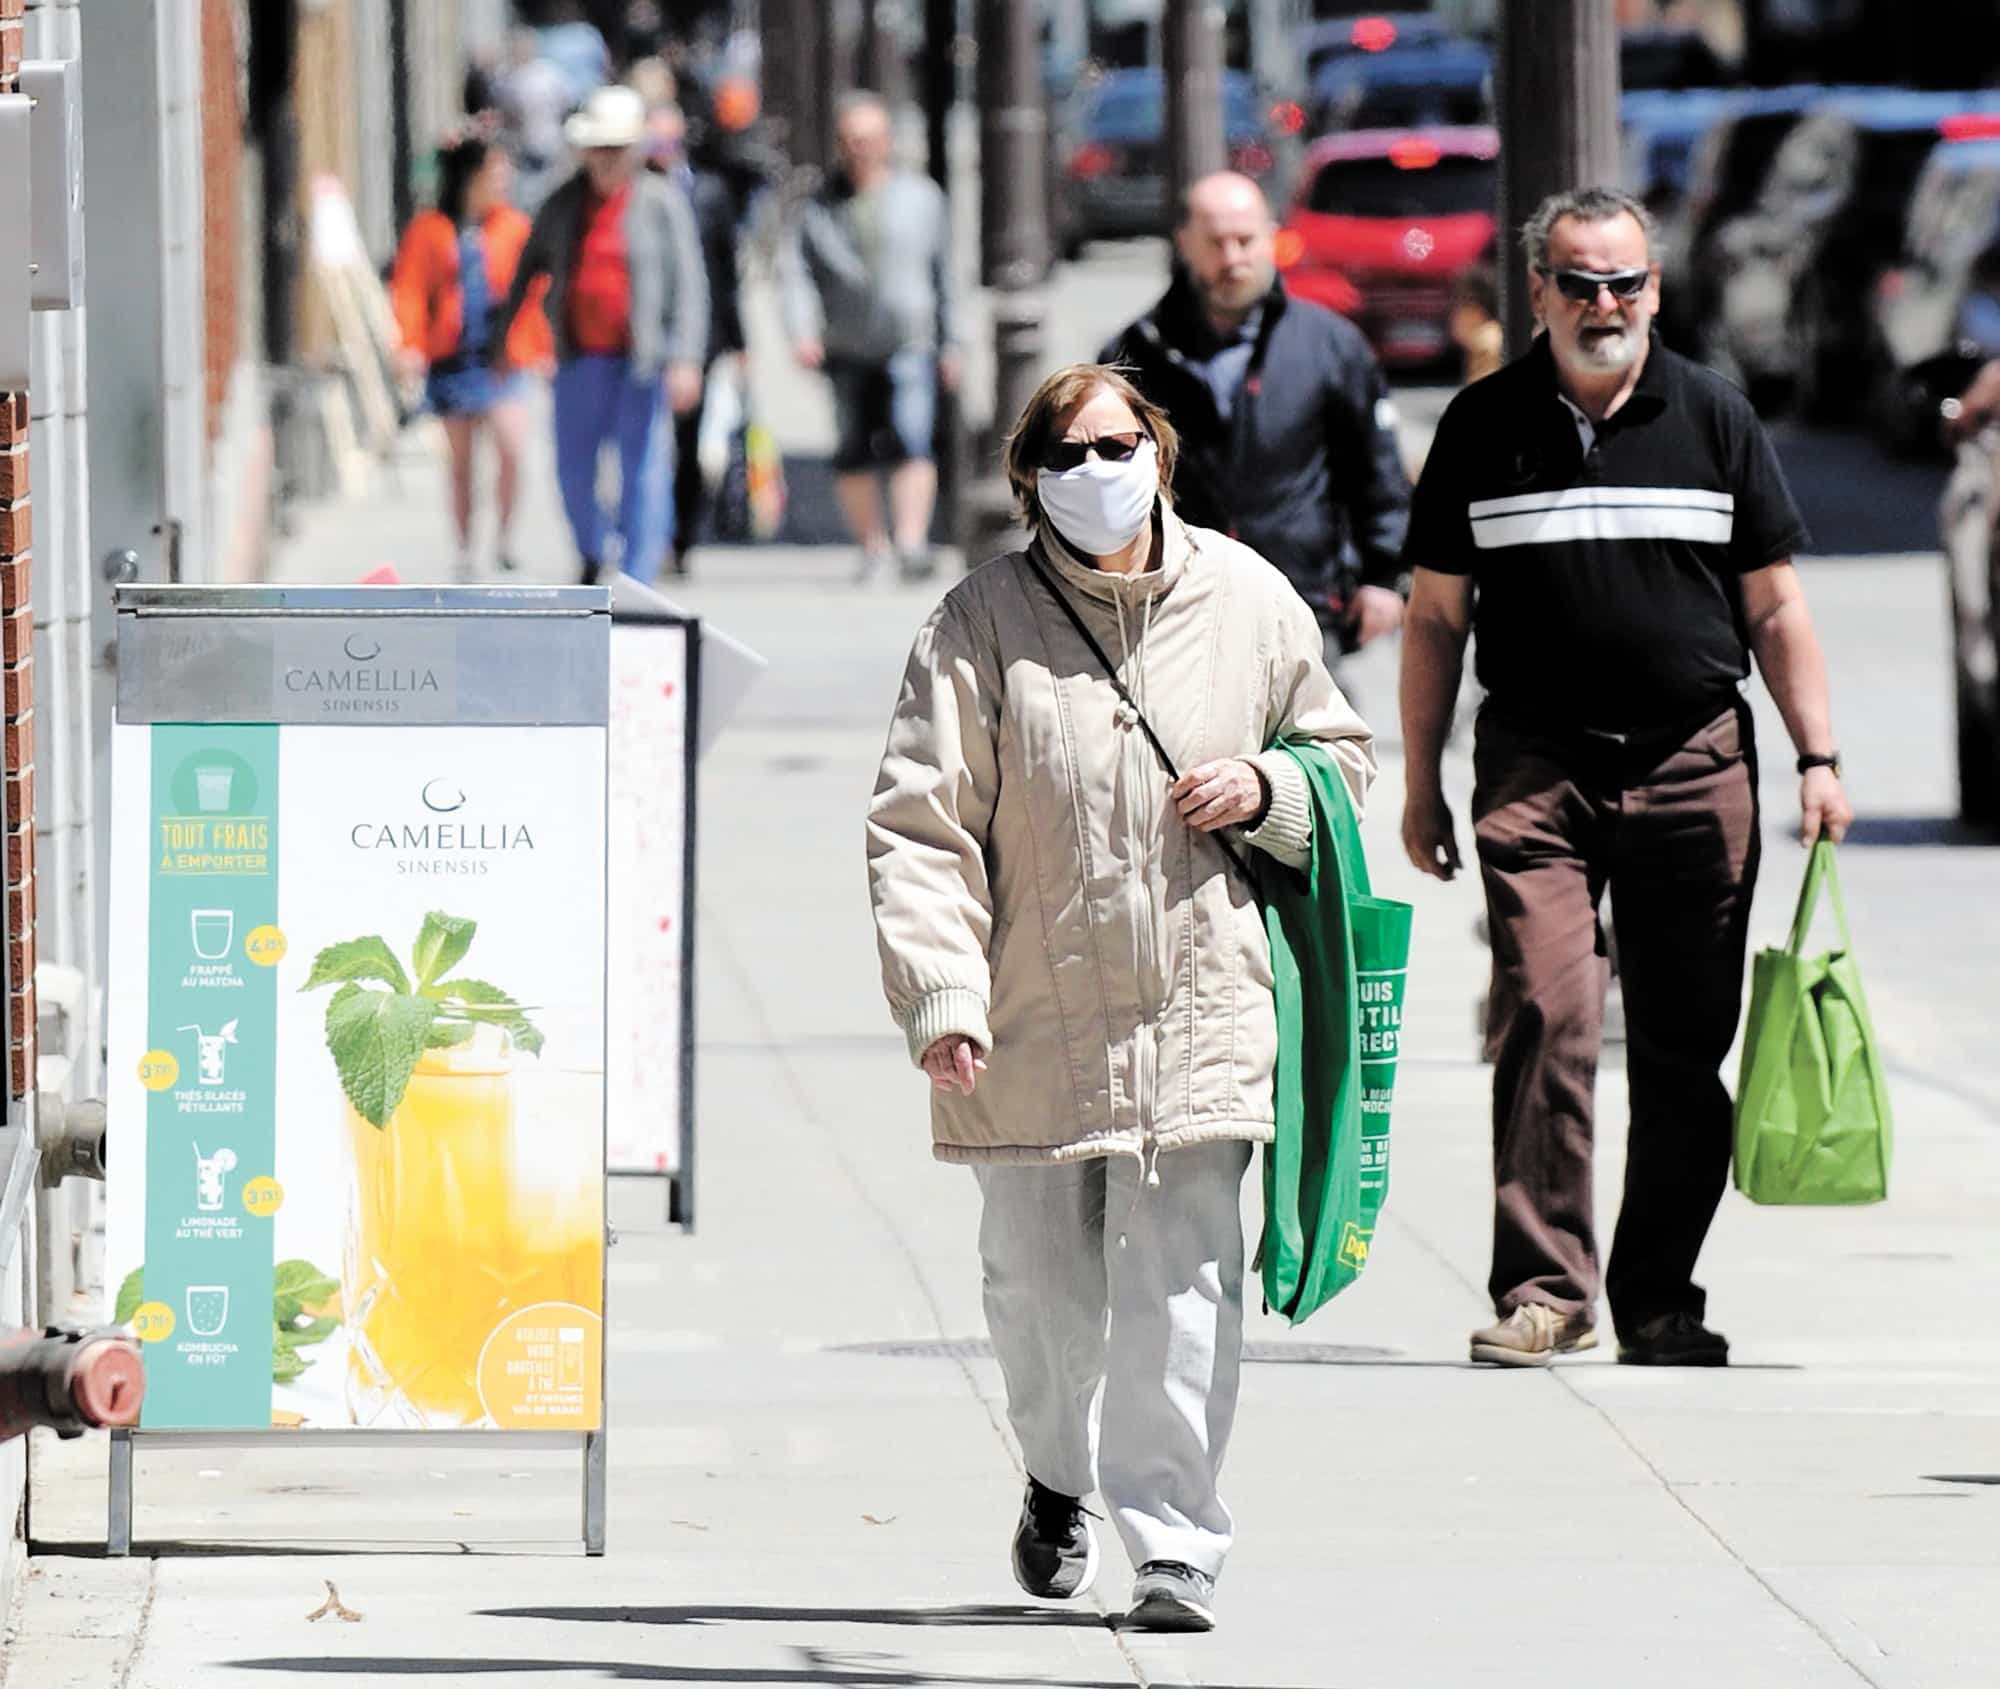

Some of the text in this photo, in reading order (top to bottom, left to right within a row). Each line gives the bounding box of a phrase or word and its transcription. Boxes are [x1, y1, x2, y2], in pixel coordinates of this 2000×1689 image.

[285, 669, 438, 692] CAMELLIA
[322, 700, 400, 713] SINENSIS
[160, 823, 268, 849] TOUT FRAIS
[351, 823, 535, 850] CAMELLIA
[177, 854, 266, 869] EMPORTER
[396, 860, 488, 875] SINENSIS
[190, 964, 233, 976] FRAPPÉ
[181, 976, 244, 987] AU MATCHA
[182, 1216, 237, 1227] LIMONADE
[176, 1228, 191, 1238] AU
[215, 1228, 243, 1239] VERT
[176, 1343, 239, 1354] KOMBUCHA
